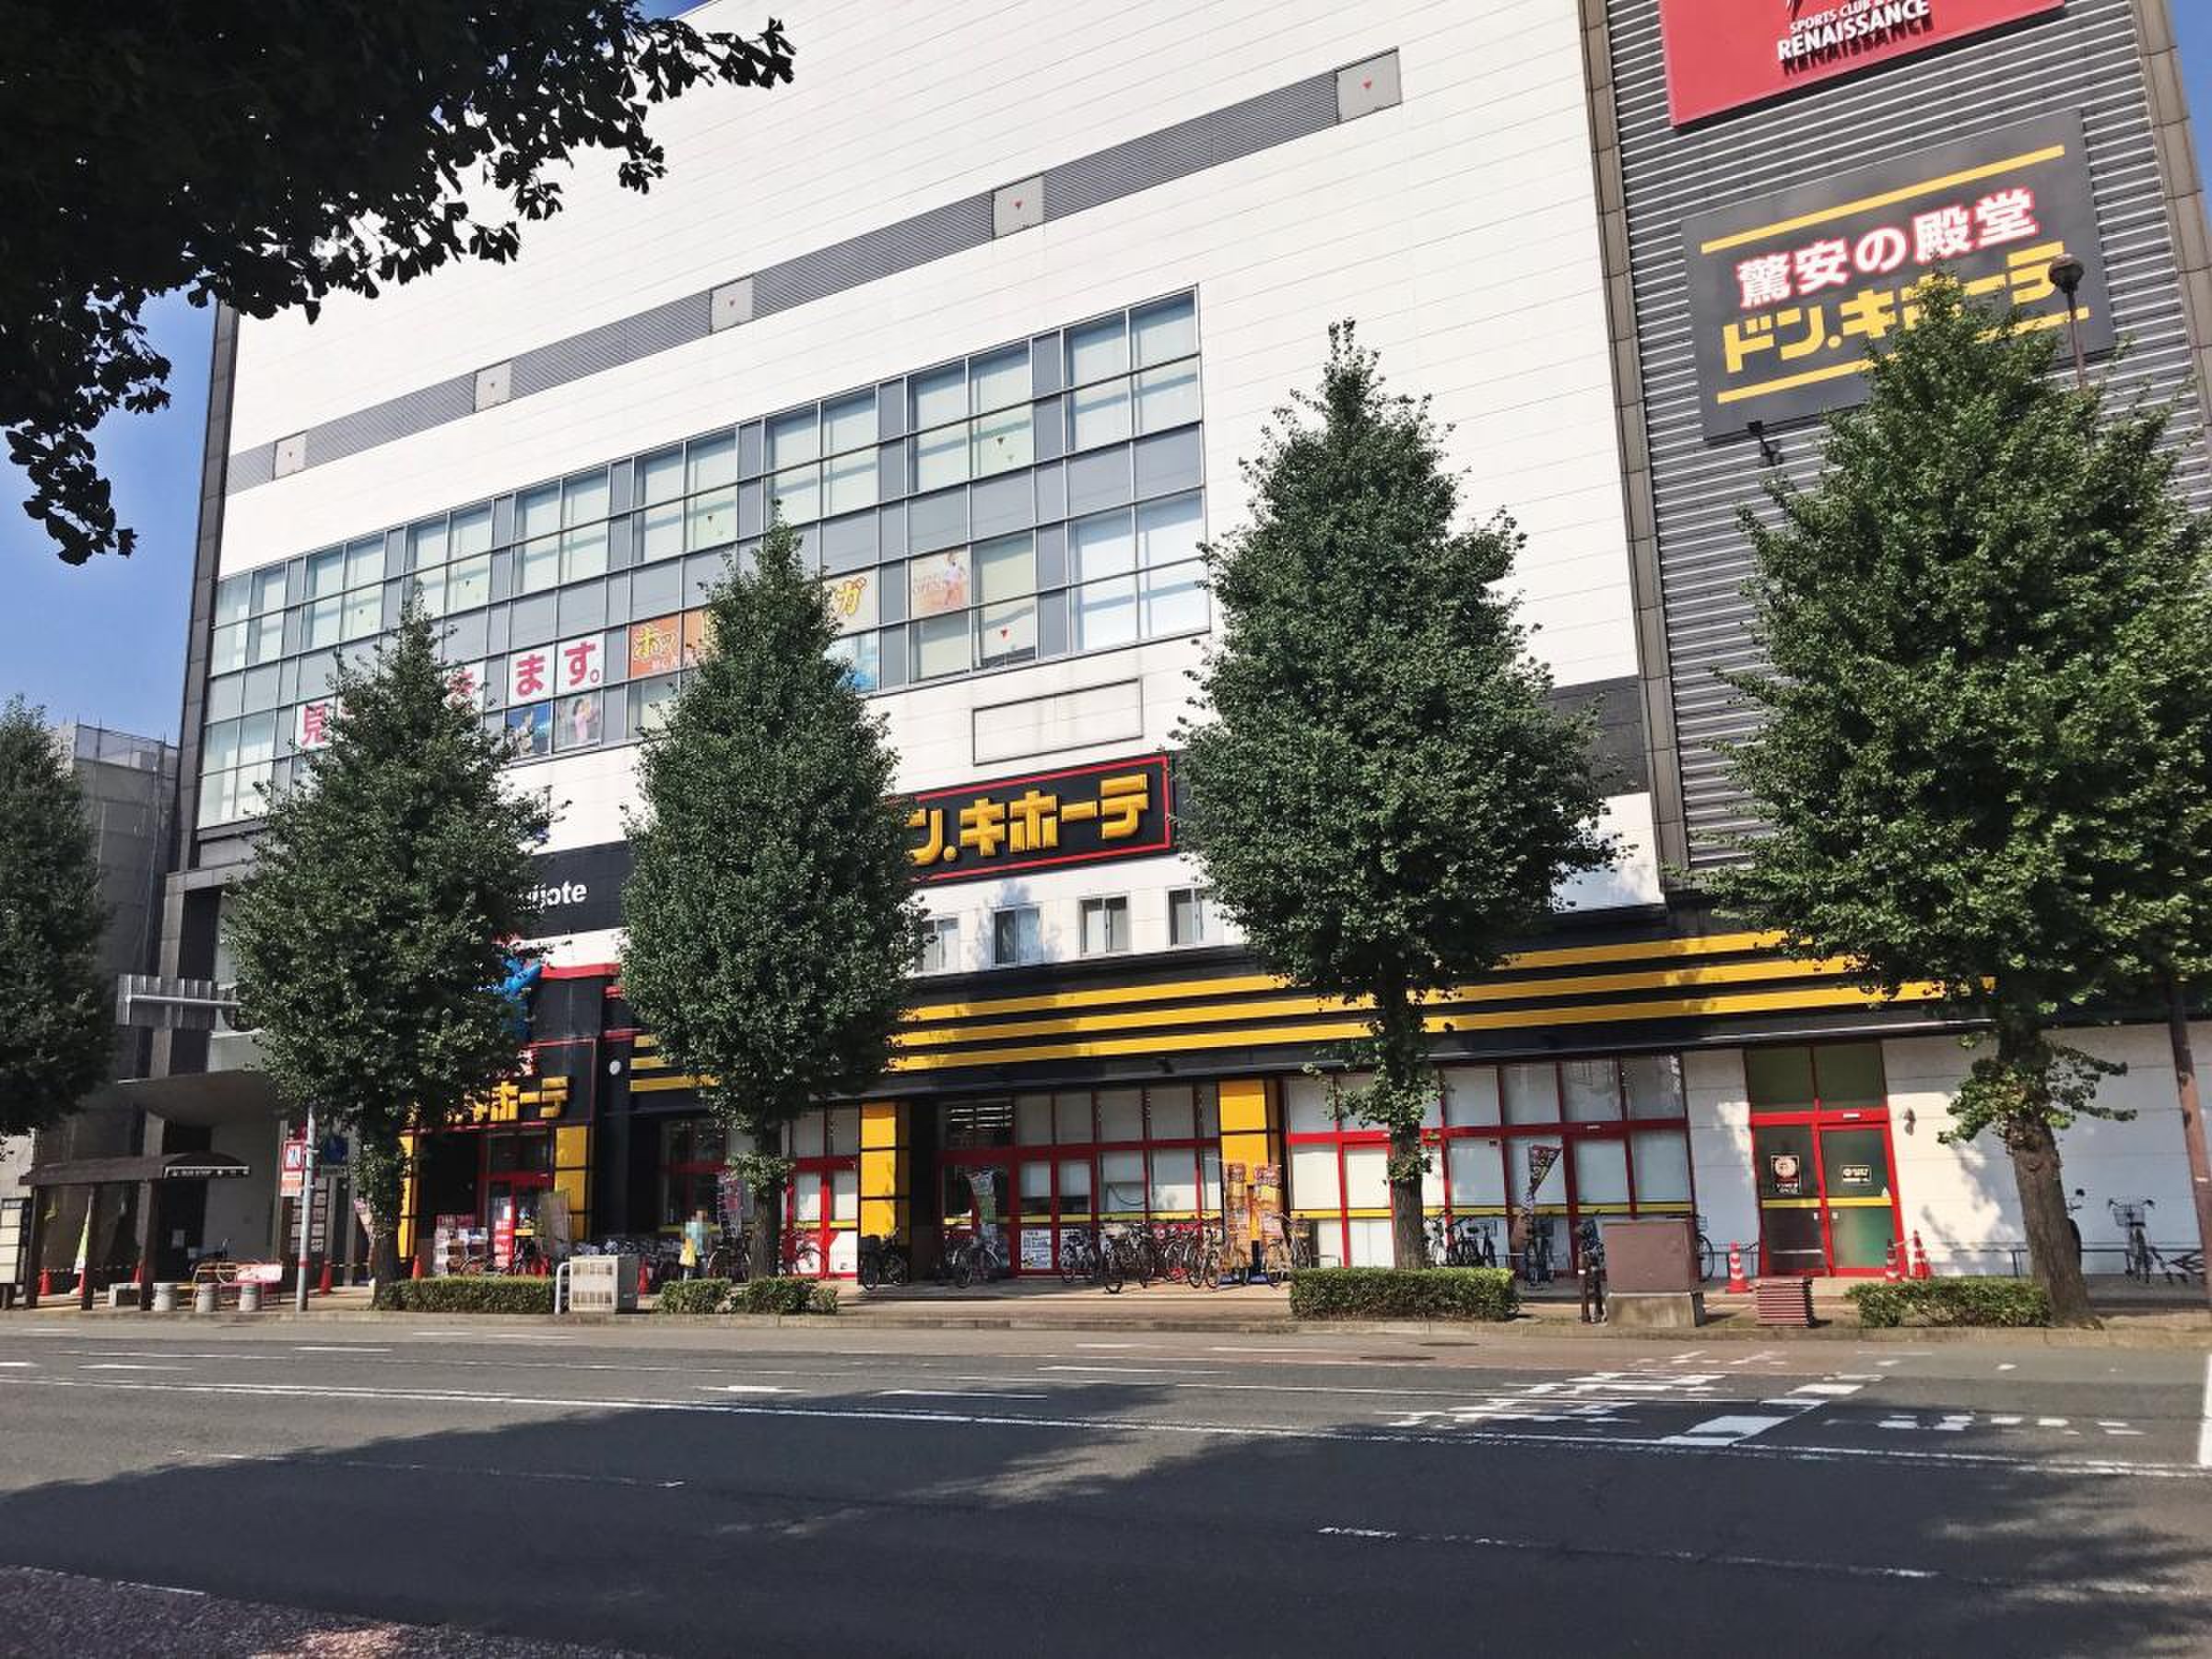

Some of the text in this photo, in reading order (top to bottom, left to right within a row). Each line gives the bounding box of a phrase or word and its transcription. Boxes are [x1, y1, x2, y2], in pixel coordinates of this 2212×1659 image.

[1777, 0, 1930, 60] RENAISSANCE
[1790, 9, 1838, 34] SPORTS
[1736, 187, 2039, 308] 驚安の殿堂
